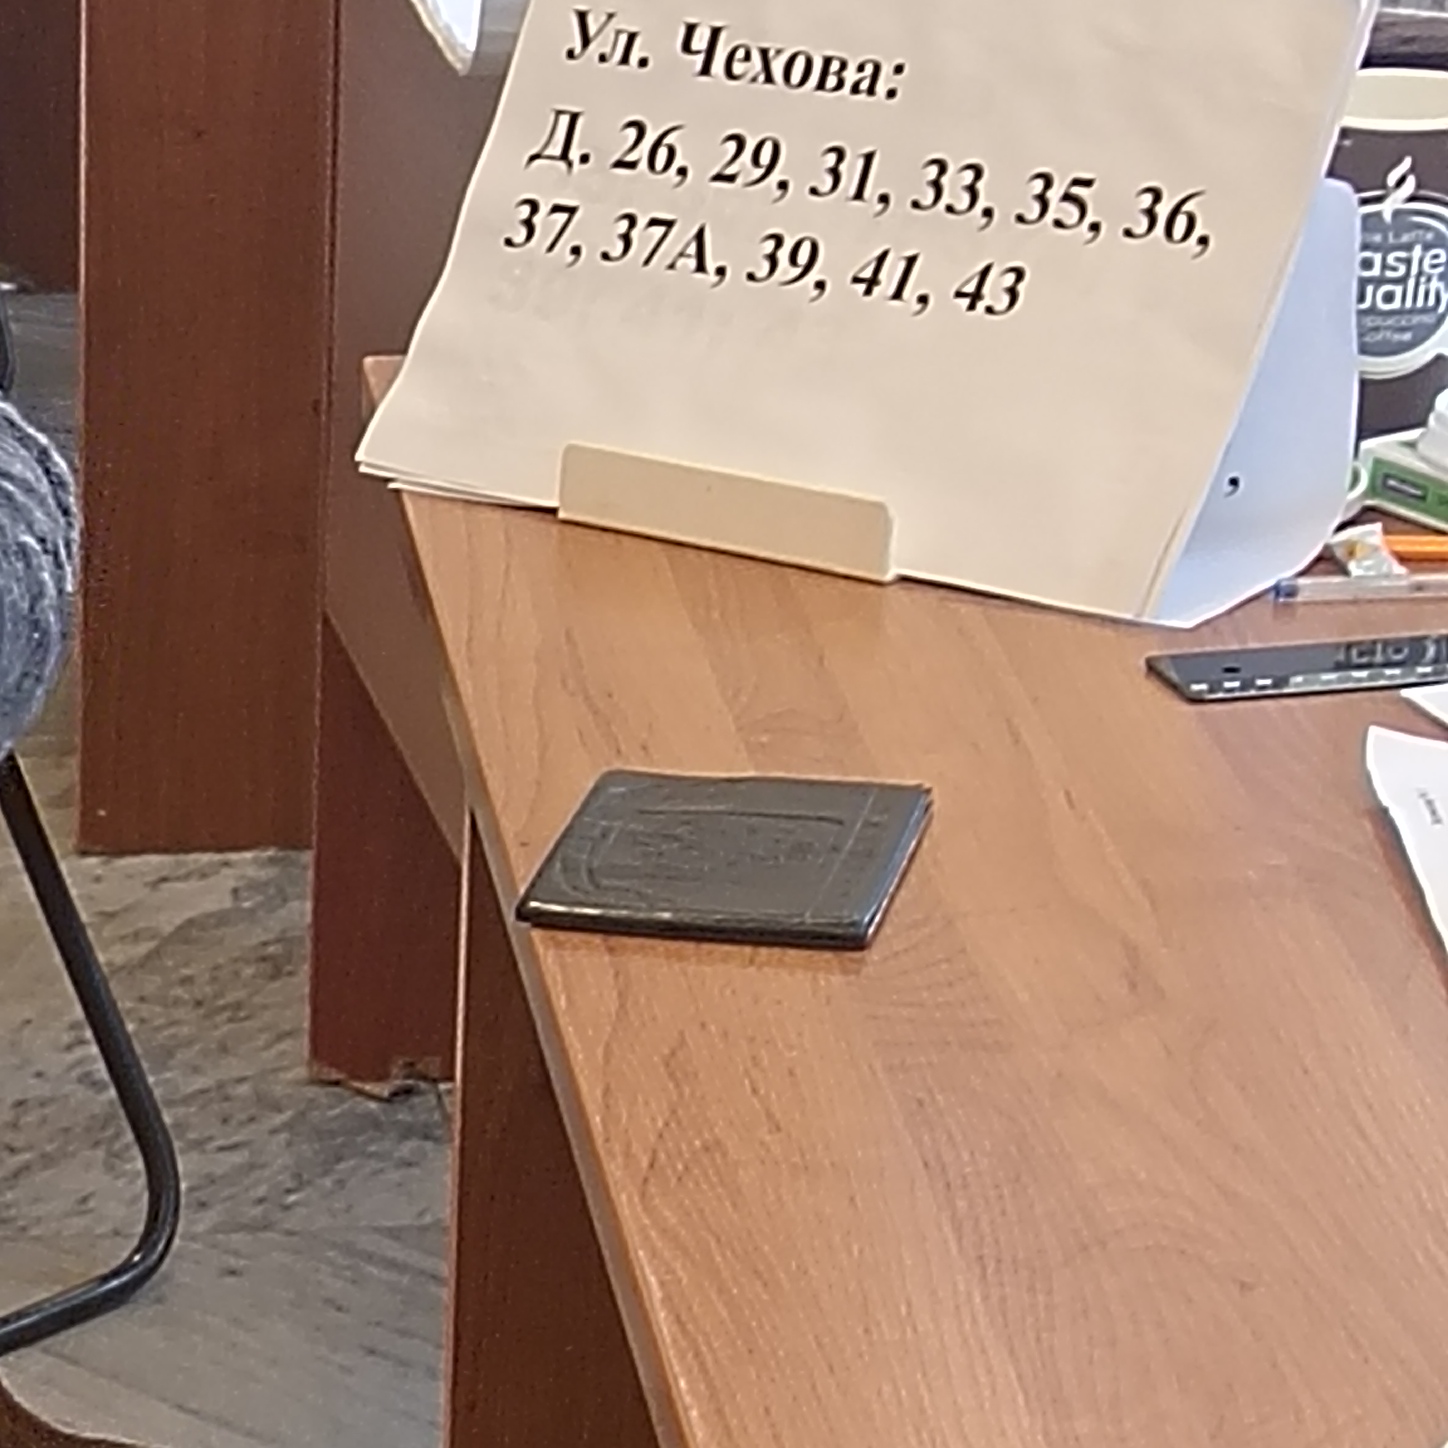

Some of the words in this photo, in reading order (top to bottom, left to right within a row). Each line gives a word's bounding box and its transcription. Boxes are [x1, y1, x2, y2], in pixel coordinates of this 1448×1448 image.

[565, 7, 650, 69] Ул.
[679, 20, 905, 100] Чехова:
[524, 107, 592, 175] Д.
[610, 118, 689, 190] 26,
[708, 132, 790, 203] 29,
[808, 145, 891, 218] 31,
[910, 157, 995, 232] 33,
[1014, 171, 1102, 245] 35,
[1122, 185, 1210, 260] 36,
[503, 197, 584, 268] 37,
[600, 211, 728, 288] 37А,
[745, 232, 828, 302] 39,
[850, 247, 930, 317] 41,
[952, 261, 1027, 316] 43
[1357, 277, 1448, 314] uality
[1358, 243, 1447, 278] aste
